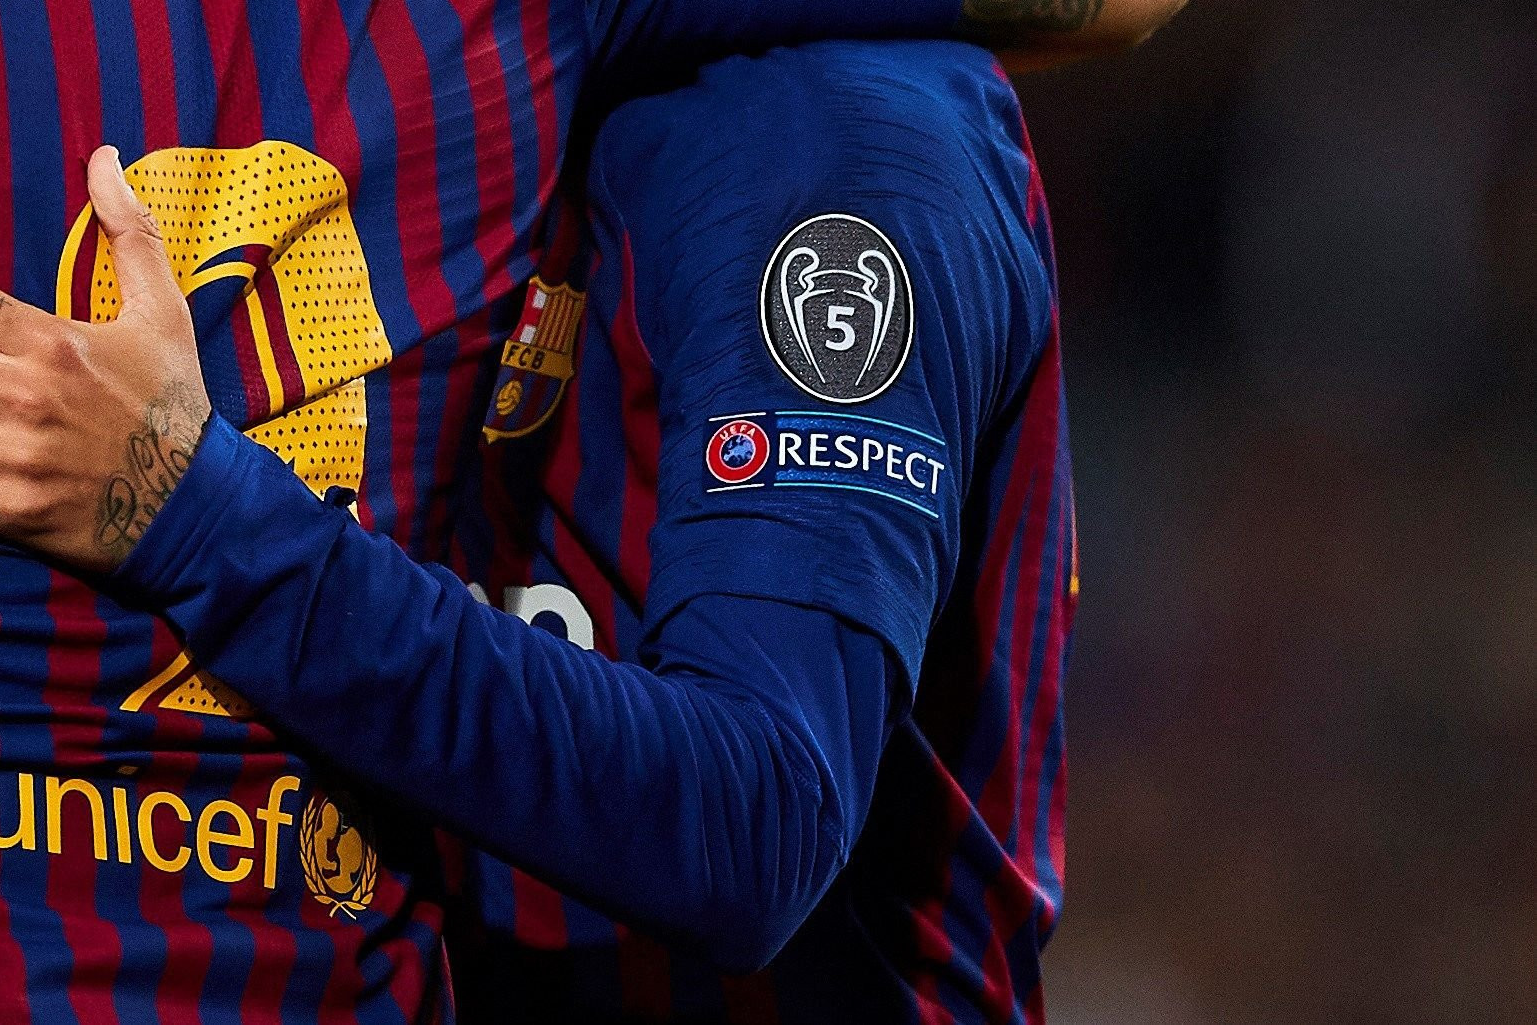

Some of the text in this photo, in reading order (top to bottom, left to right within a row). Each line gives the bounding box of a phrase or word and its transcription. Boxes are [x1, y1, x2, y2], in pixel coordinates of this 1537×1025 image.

[825, 305, 856, 351] 5
[505, 344, 545, 370] FCB
[719, 424, 756, 441] UEFA
[778, 432, 945, 494] RESPECT
